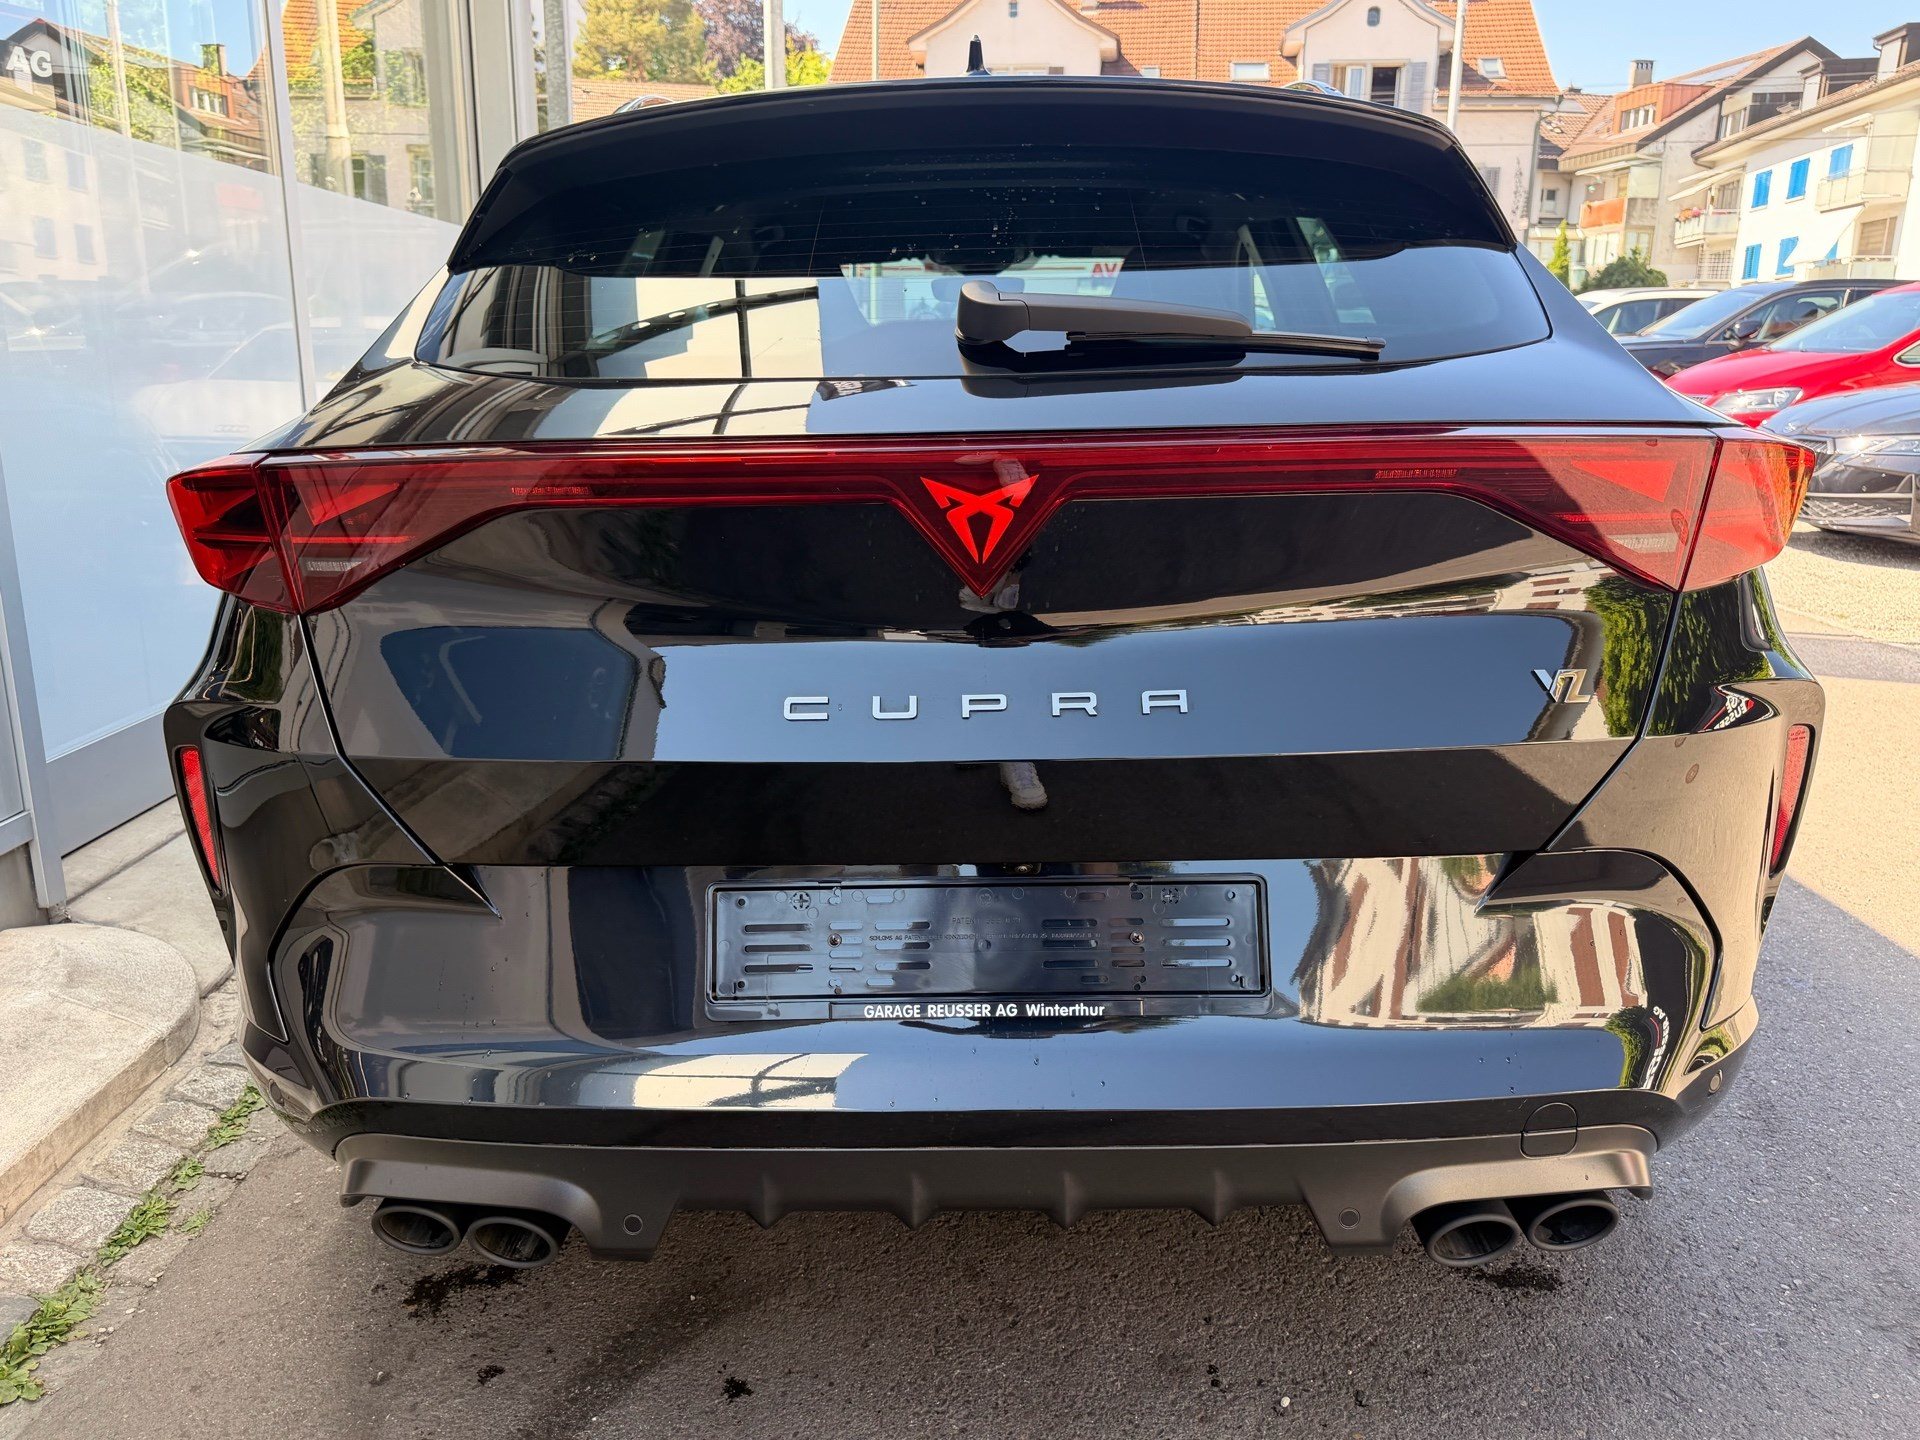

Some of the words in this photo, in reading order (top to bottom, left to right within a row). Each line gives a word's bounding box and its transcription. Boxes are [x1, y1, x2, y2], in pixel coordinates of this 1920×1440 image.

[6, 46, 53, 78] AG
[783, 689, 1188, 720] CUPRA
[864, 1004, 921, 1018] GARAGE
[927, 1004, 991, 1018] REUSSER
[996, 1003, 1018, 1017] AG
[1026, 1003, 1105, 1017] Winterthur
